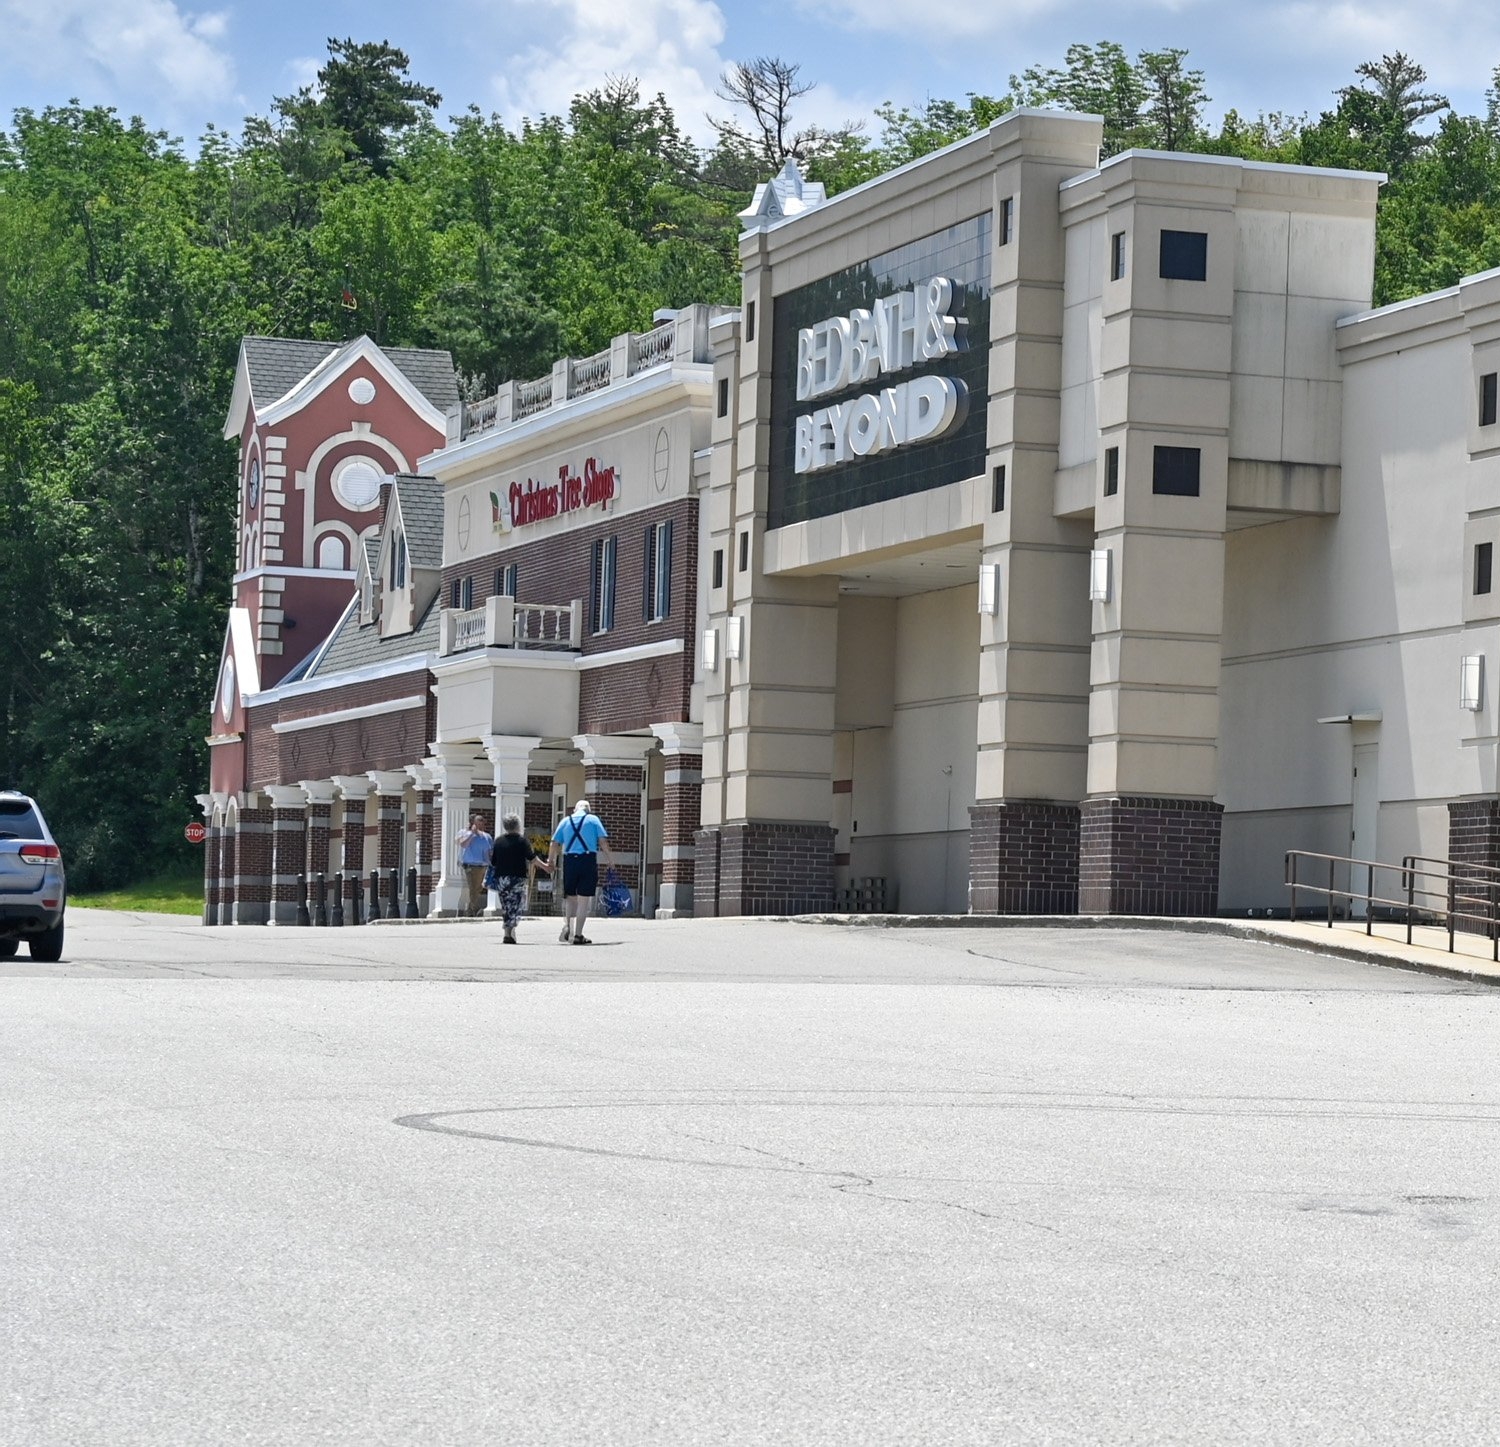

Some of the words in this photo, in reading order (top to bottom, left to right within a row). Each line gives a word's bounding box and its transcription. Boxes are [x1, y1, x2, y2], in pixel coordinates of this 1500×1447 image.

[797, 316, 850, 401] BED
[849, 283, 928, 384] BATH
[922, 276, 958, 359] &
[795, 375, 958, 474] BEYOND
[509, 478, 559, 527] Christmas
[559, 465, 582, 513] Tree
[583, 457, 615, 511] Shops
[186, 828, 205, 837] STOP
